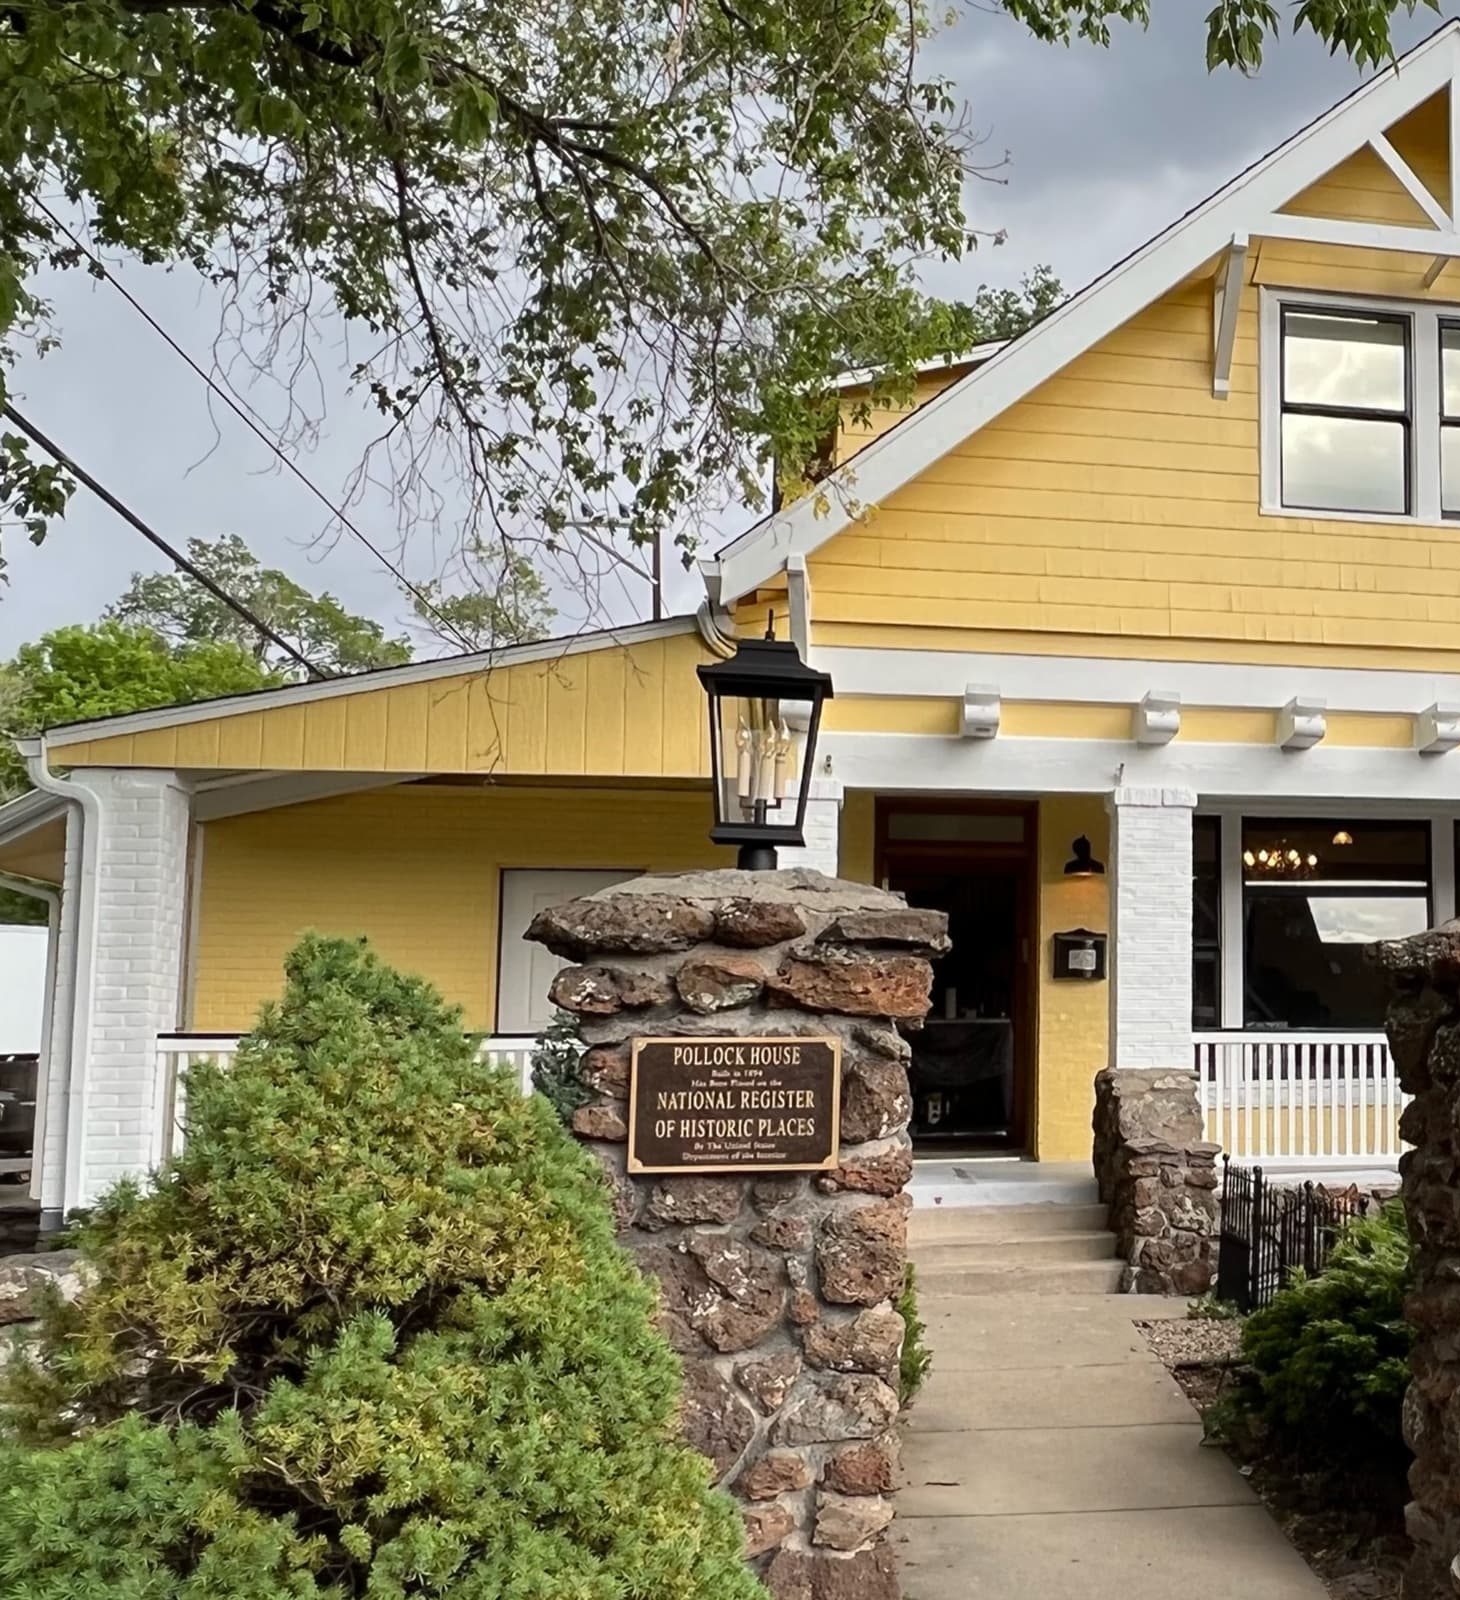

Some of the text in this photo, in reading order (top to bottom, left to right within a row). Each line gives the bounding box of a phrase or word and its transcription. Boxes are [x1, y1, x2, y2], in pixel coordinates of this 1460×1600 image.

[674, 1047, 801, 1065] POLLOCK HOUSE
[657, 1090, 815, 1110] NATIONAL REGISTER
[655, 1118, 815, 1138] OF HISTORIC PLACES
